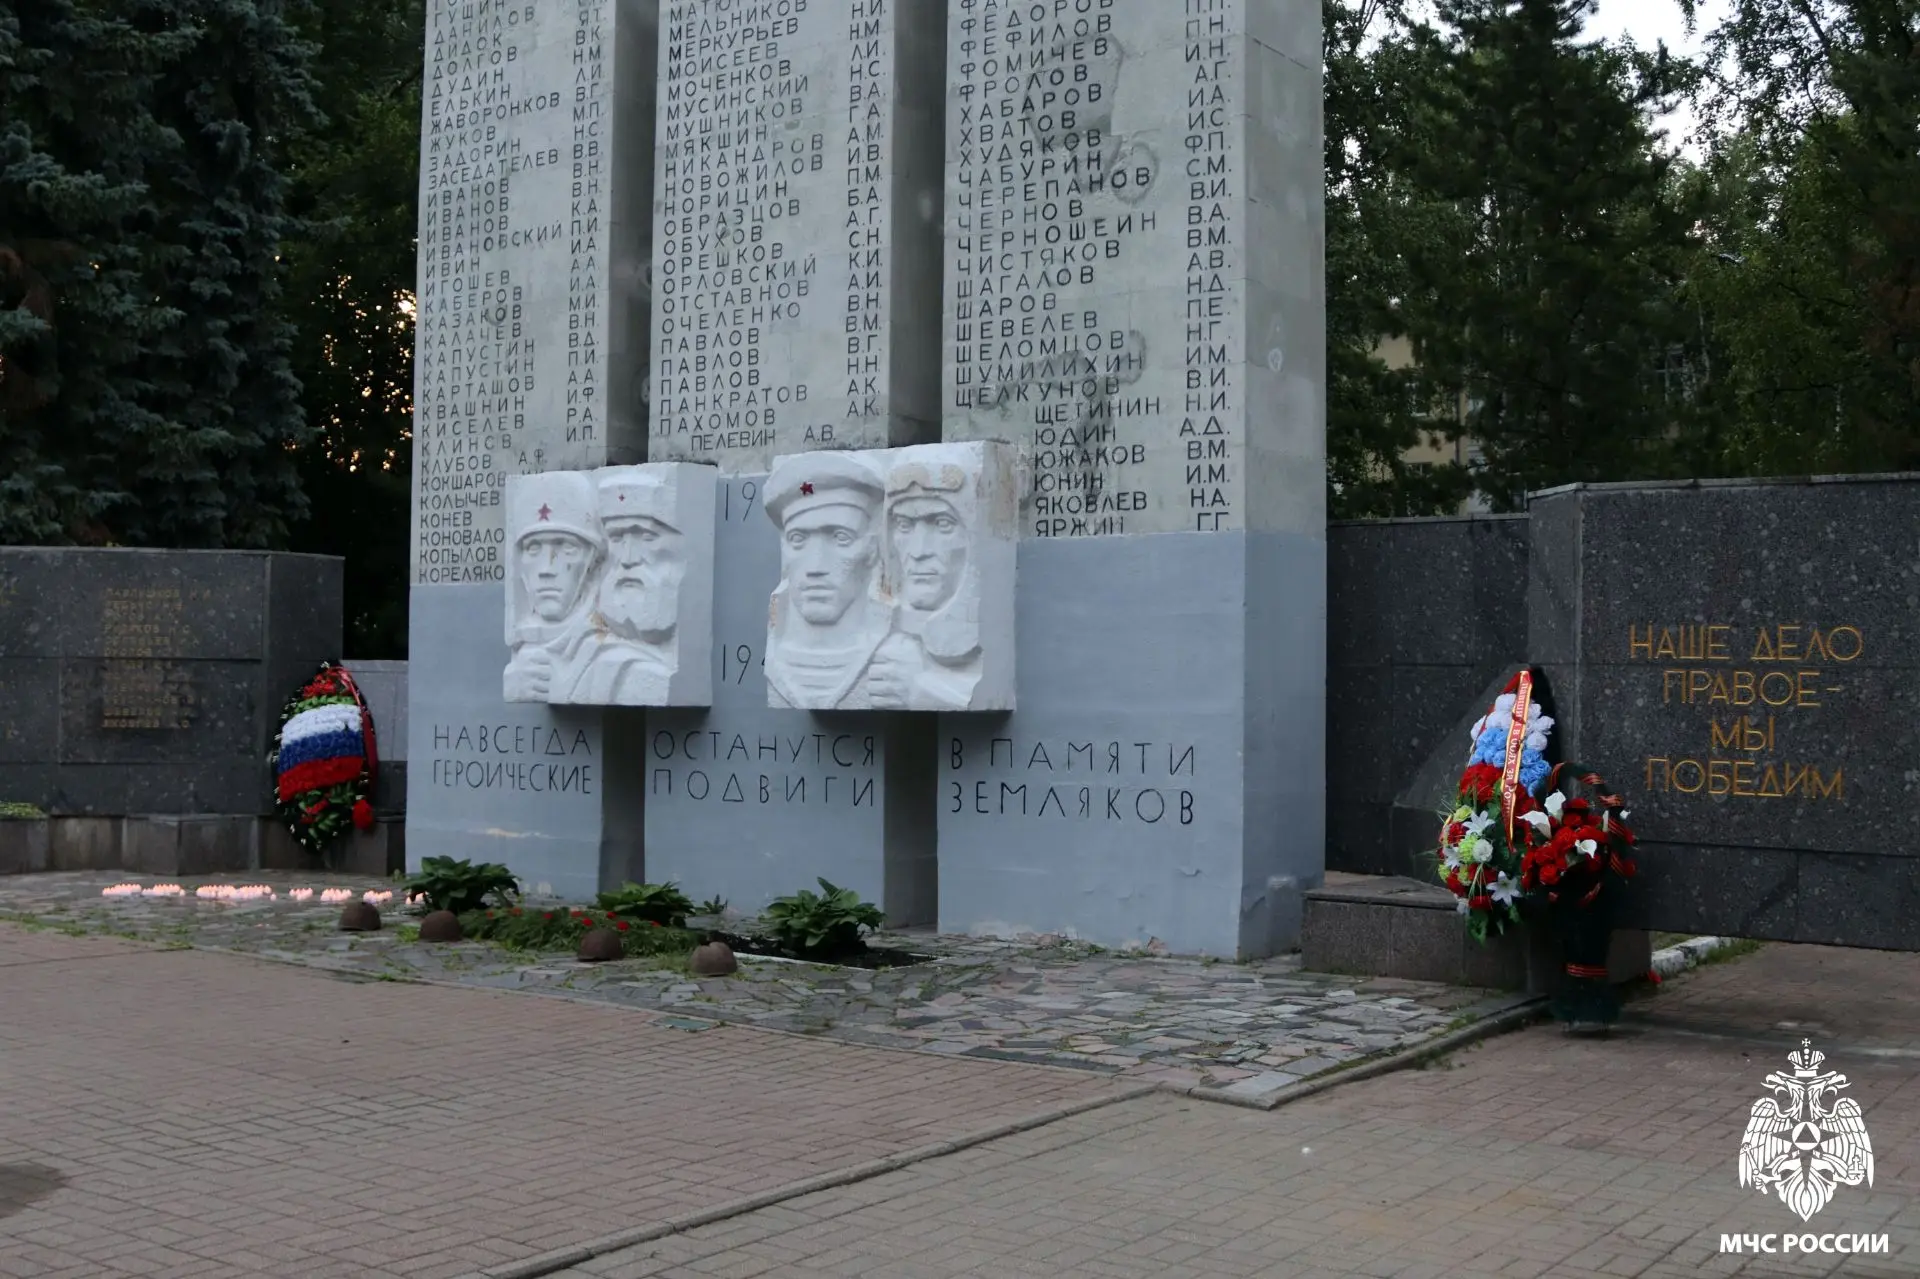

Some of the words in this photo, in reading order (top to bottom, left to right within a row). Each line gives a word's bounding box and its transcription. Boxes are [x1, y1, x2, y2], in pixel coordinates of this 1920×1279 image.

[434, 6, 534, 44] ДАНИЛОВ
[669, 18, 798, 62] МЕРКУРЬЕВ
[852, 0, 886, 20] Н.И.
[960, 14, 1111, 58] ФЕФИЛОВ
[433, 46, 517, 80] ДОЛГОВ
[434, 33, 502, 62] ДИДОК
[668, 42, 778, 81] МОИСЕЕВ
[960, 38, 1108, 80] ФОМИЧЕВ
[1186, 14, 1230, 39] П.Н.
[432, 68, 503, 98] ДУДИН
[668, 60, 790, 101] МОЧЕНКОВ
[852, 40, 885, 61] Л.И.
[668, 74, 808, 121] МУСИНСКИЙ
[850, 60, 885, 82] Н.С.
[960, 64, 1087, 103] ФРОЛОВ
[1186, 38, 1231, 63] И.Н.
[432, 83, 510, 116] ЕЛЬКИН
[667, 98, 802, 140] МУШНИКОВ
[850, 82, 886, 103] В.А.
[961, 83, 1101, 125] ХАБАРОВ
[1195, 60, 1231, 84] А.Г.
[431, 92, 560, 134] ЖАВОРОНКОВ
[666, 124, 766, 159] МЯКШИН
[849, 102, 884, 123] Г.А.
[960, 111, 1075, 147] ХВАТОВ
[1189, 84, 1230, 108] И.А.
[430, 138, 520, 172] ЗАДОРИН
[431, 126, 496, 152] ЖУКОВ
[666, 134, 823, 178] НИКАНДРОВ
[847, 122, 883, 144] А.М.
[960, 128, 1100, 168] ХУДЯКОВ
[1189, 108, 1230, 130] И.С.
[429, 149, 558, 190] ЗАСЕДАТЕЛЕВ
[665, 154, 822, 199] НОВОЖИЛОВ
[848, 144, 883, 165] И.В.
[959, 150, 1100, 188] ЧАБУРИН
[1184, 131, 1231, 154] Ф.П.
[428, 177, 508, 208] ИВАНОВ
[664, 180, 787, 217] НОРИЦИН
[848, 165, 882, 185] П.М.
[959, 167, 1150, 210] ЧЕРЕПАНОВ
[1186, 154, 1231, 177] С.М.
[428, 197, 508, 226] ИВАНОВ
[664, 199, 800, 236] ОБРАЗЦОВ
[848, 186, 882, 207] Б.А.
[958, 200, 1082, 232] ЧЕРНОВ
[1191, 178, 1231, 200] В.И.
[426, 222, 561, 262] ИВАНОВСКИЙ
[427, 215, 508, 244] ИВАНОВ
[664, 225, 762, 256] ОБУХОВ
[846, 206, 882, 228] А.Г.
[958, 211, 1155, 254] ЧЕРНОШЕИН
[1188, 203, 1230, 225] В.А.
[426, 257, 480, 279] ИВИН
[663, 243, 782, 275] ОРЕШКОВ
[849, 228, 882, 248] С.Н.
[958, 240, 1120, 276] ЧИСТЯКОВ
[1188, 226, 1231, 248] В.М.
[426, 270, 509, 297] ИГОШЕВ
[663, 253, 816, 295] ОРЛОВСКИЙ
[849, 248, 882, 270] К.И.
[957, 266, 1094, 299] ШАГАЛОВ
[1187, 250, 1231, 272] А.В.
[425, 286, 522, 314] КАБЕРОВ
[662, 280, 808, 314] ОТСТАВНОВ
[848, 271, 882, 291] А.И.
[957, 293, 1056, 320] ШАРОВ
[1187, 274, 1231, 294] Н.Д.
[425, 304, 521, 332] КАЗАКОВ
[662, 302, 800, 334] ОЧЕЛЕНКО
[848, 292, 881, 312] В.Н.
[957, 311, 1097, 342] ШЕВЕЛЕВ
[1187, 297, 1230, 319] П.Е.
[1187, 321, 1231, 342] Н.Г.
[424, 322, 521, 350] КАЛАЧЕВ
[424, 339, 534, 368] КАПУСТИН
[662, 328, 759, 354] ПАВЛОВ
[846, 313, 881, 333] В.М.
[424, 358, 533, 385] КАПУСТИН
[661, 369, 759, 395] ПАВЛОВ
[848, 355, 881, 375] Н.Н.
[662, 348, 758, 376] ПАВЛОВ
[848, 334, 881, 354] В.Г.
[956, 351, 1143, 386] ШУМИЛИХИН
[1186, 344, 1230, 366] И.М.
[423, 376, 534, 402] КАРТАШОВ
[423, 396, 524, 421] КВАШНИН
[660, 385, 807, 416] ПАНКРАТОВ
[847, 376, 880, 396] А.К.
[956, 377, 1120, 409] ЩЕЛКУНОВ
[1187, 368, 1230, 389] В.И.
[1186, 391, 1230, 412] Н.И.
[422, 414, 524, 438] КИСЕЛЕВ
[660, 408, 774, 437] ПАХОМОВ
[847, 397, 880, 418] А.К.
[1035, 424, 1116, 448] ЮДИН
[1179, 416, 1231, 437] А.Д.
[691, 429, 776, 451] ПЕЛЕВИН
[803, 424, 836, 443] А.В.
[1034, 444, 1144, 470] ЮЖАКОВ
[1188, 439, 1230, 460] В.М.
[421, 472, 506, 492] КОКШАРОВ
[422, 454, 491, 476] КЛУБОВ
[1034, 472, 1104, 492] ЮНИН
[1187, 464, 1230, 484] И.М.
[420, 490, 500, 510] КОЛЫЧЕВ
[421, 511, 472, 528] КОНЕВ
[1035, 491, 1147, 515] ЯКОВЛЕВ
[1191, 488, 1230, 508] Н.А.
[1197, 512, 1229, 531] Г.Г.
[420, 546, 496, 564] КОПЫЛОВ
[1629, 622, 1731, 659] НАШЕ
[1751, 623, 1863, 661] ДЕЛО
[434, 725, 591, 755] НАВСЕГДА
[653, 730, 875, 767] ОСТАНУТСЯ
[951, 738, 963, 769] В
[991, 738, 1195, 776] ПАМЯТИ
[1711, 715, 1777, 751] МЫ
[433, 759, 592, 795] ГЕРОИЧЕСКИЕ
[653, 769, 875, 807] ПОДВИГИ
[951, 781, 1194, 825] ЗЕМЛЯКОВ
[1645, 756, 1846, 800] ПОБЕДИМ
